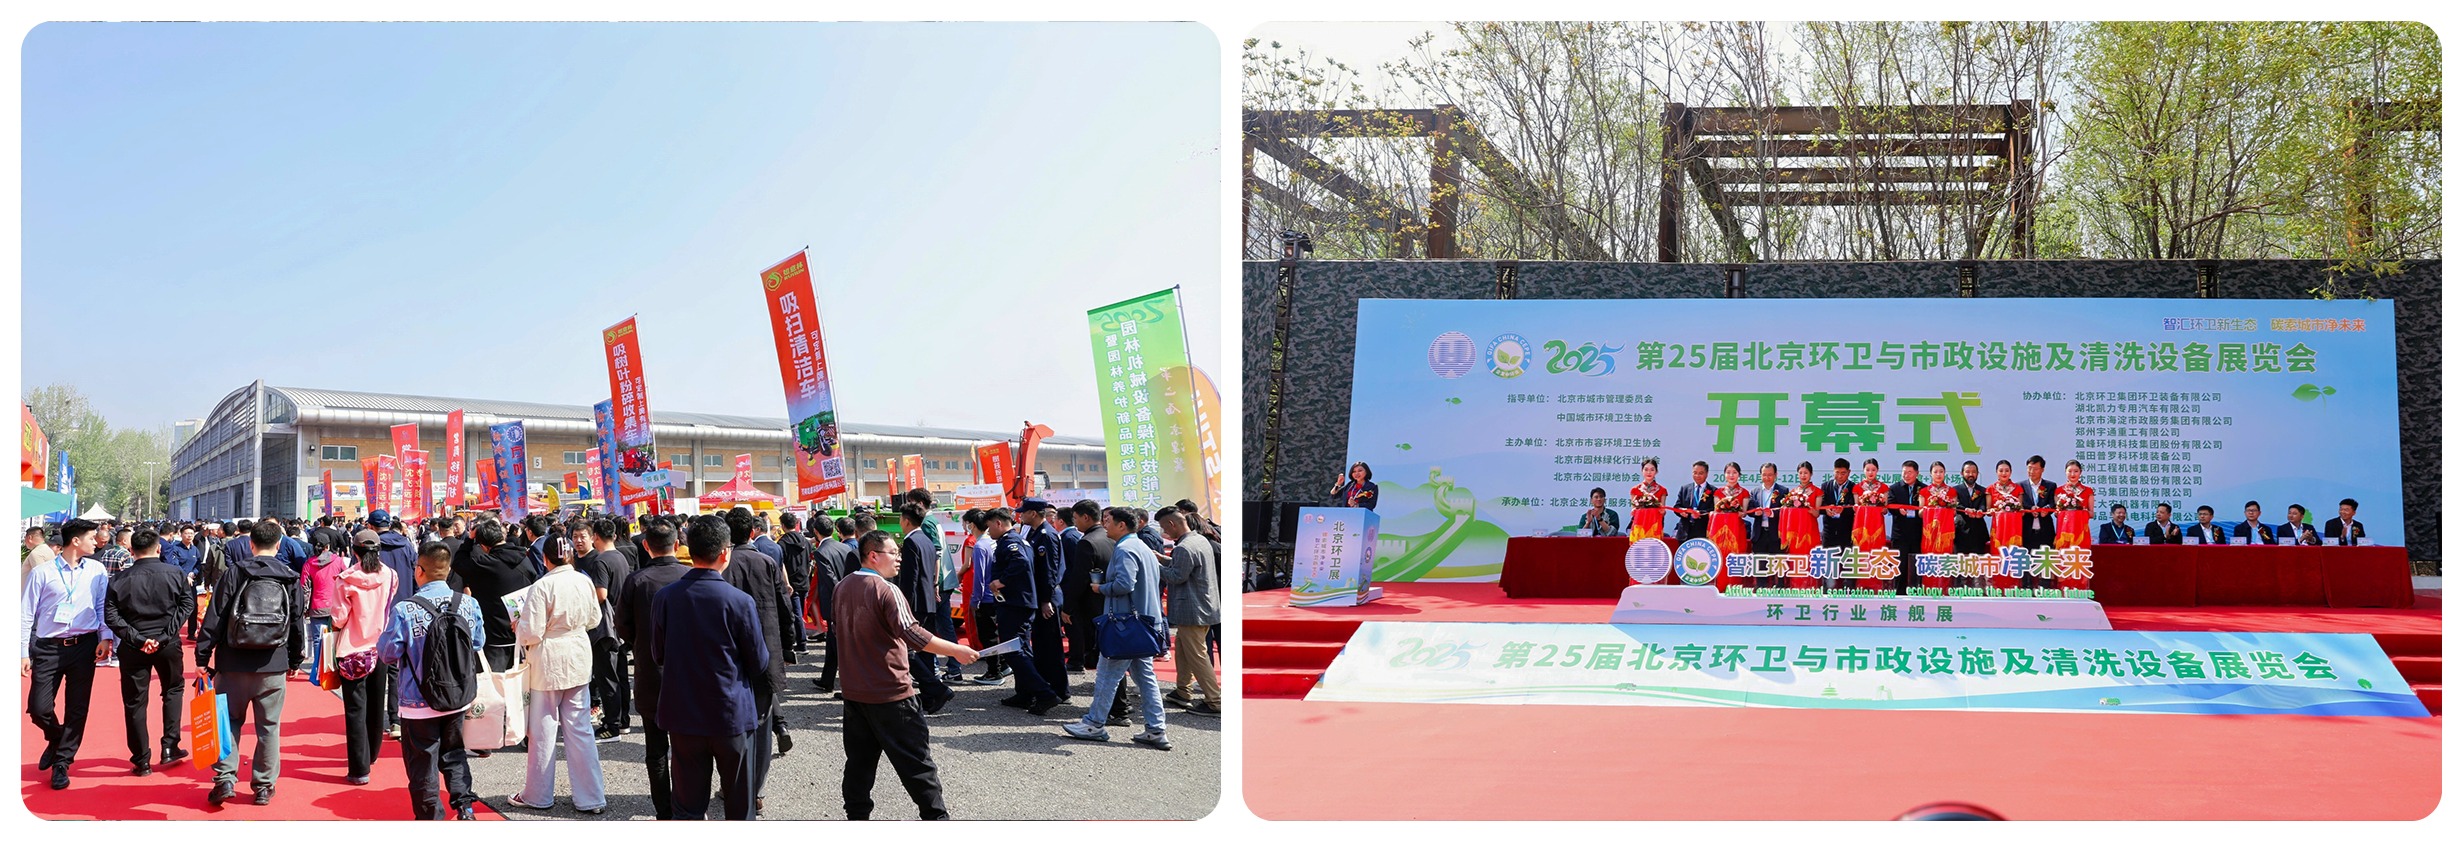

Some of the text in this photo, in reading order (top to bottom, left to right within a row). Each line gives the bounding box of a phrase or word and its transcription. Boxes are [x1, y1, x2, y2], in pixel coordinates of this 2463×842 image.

[2162, 317, 2366, 332] 智汇环卫新生态 碳索城市净未来
[1498, 334, 1519, 342] CHINA
[779, 291, 817, 399] 吸扫清洁车
[1543, 339, 1626, 377] 2025
[1636, 341, 2317, 373] 第25届北京环卫与市政设施及清洗设备展览会
[612, 343, 638, 442] 吸树叶粉碎收集车
[2075, 392, 2222, 402] 北京环卫集团环卫装备有限公司
[1507, 394, 1653, 404] 指导单位： 北京市城市管理委员会
[2075, 404, 2200, 413] 湖北凯力专用汽车有限公司
[1557, 413, 1652, 423] 中国城市环境卫生协会
[1706, 391, 1982, 454] 开幕式
[2075, 415, 2233, 426] 北京市海淀市政服务集团有限公司
[2075, 427, 2180, 437] 郑州宇通重工有限公司
[1505, 438, 1661, 448] 主办单位： 北京市市容环境卫生协会
[2075, 439, 2223, 450] 盈峰环境科技集团股份有限公司
[2075, 451, 2191, 461] 福田普罗科环境装备公司
[535, 458, 540, 466] 5
[1553, 472, 1640, 482] 北京市公园绿地协会
[1501, 497, 1545, 507] 承办单位：
[1328, 521, 1345, 580] 北京环卫展
[1686, 541, 1706, 549] CHINA
[1726, 545, 2094, 580] 智汇环卫新生态 碳索城市净未来
[1725, 584, 1753, 597] Afflux
[1756, 585, 1824, 598] environmental
[1827, 586, 1875, 599] sanitation
[1877, 588, 1897, 599] new
[1947, 586, 1983, 599] explore
[1986, 585, 2002, 598] the
[2004, 586, 2033, 598] urban
[2035, 586, 2062, 599] clean
[2064, 587, 2095, 599] future
[1766, 603, 1953, 622] 环卫行业旗舰展
[1389, 637, 1487, 670] 2025
[1493, 640, 2338, 681] 第25届北京环卫与市政设施及清洗设备展览会
